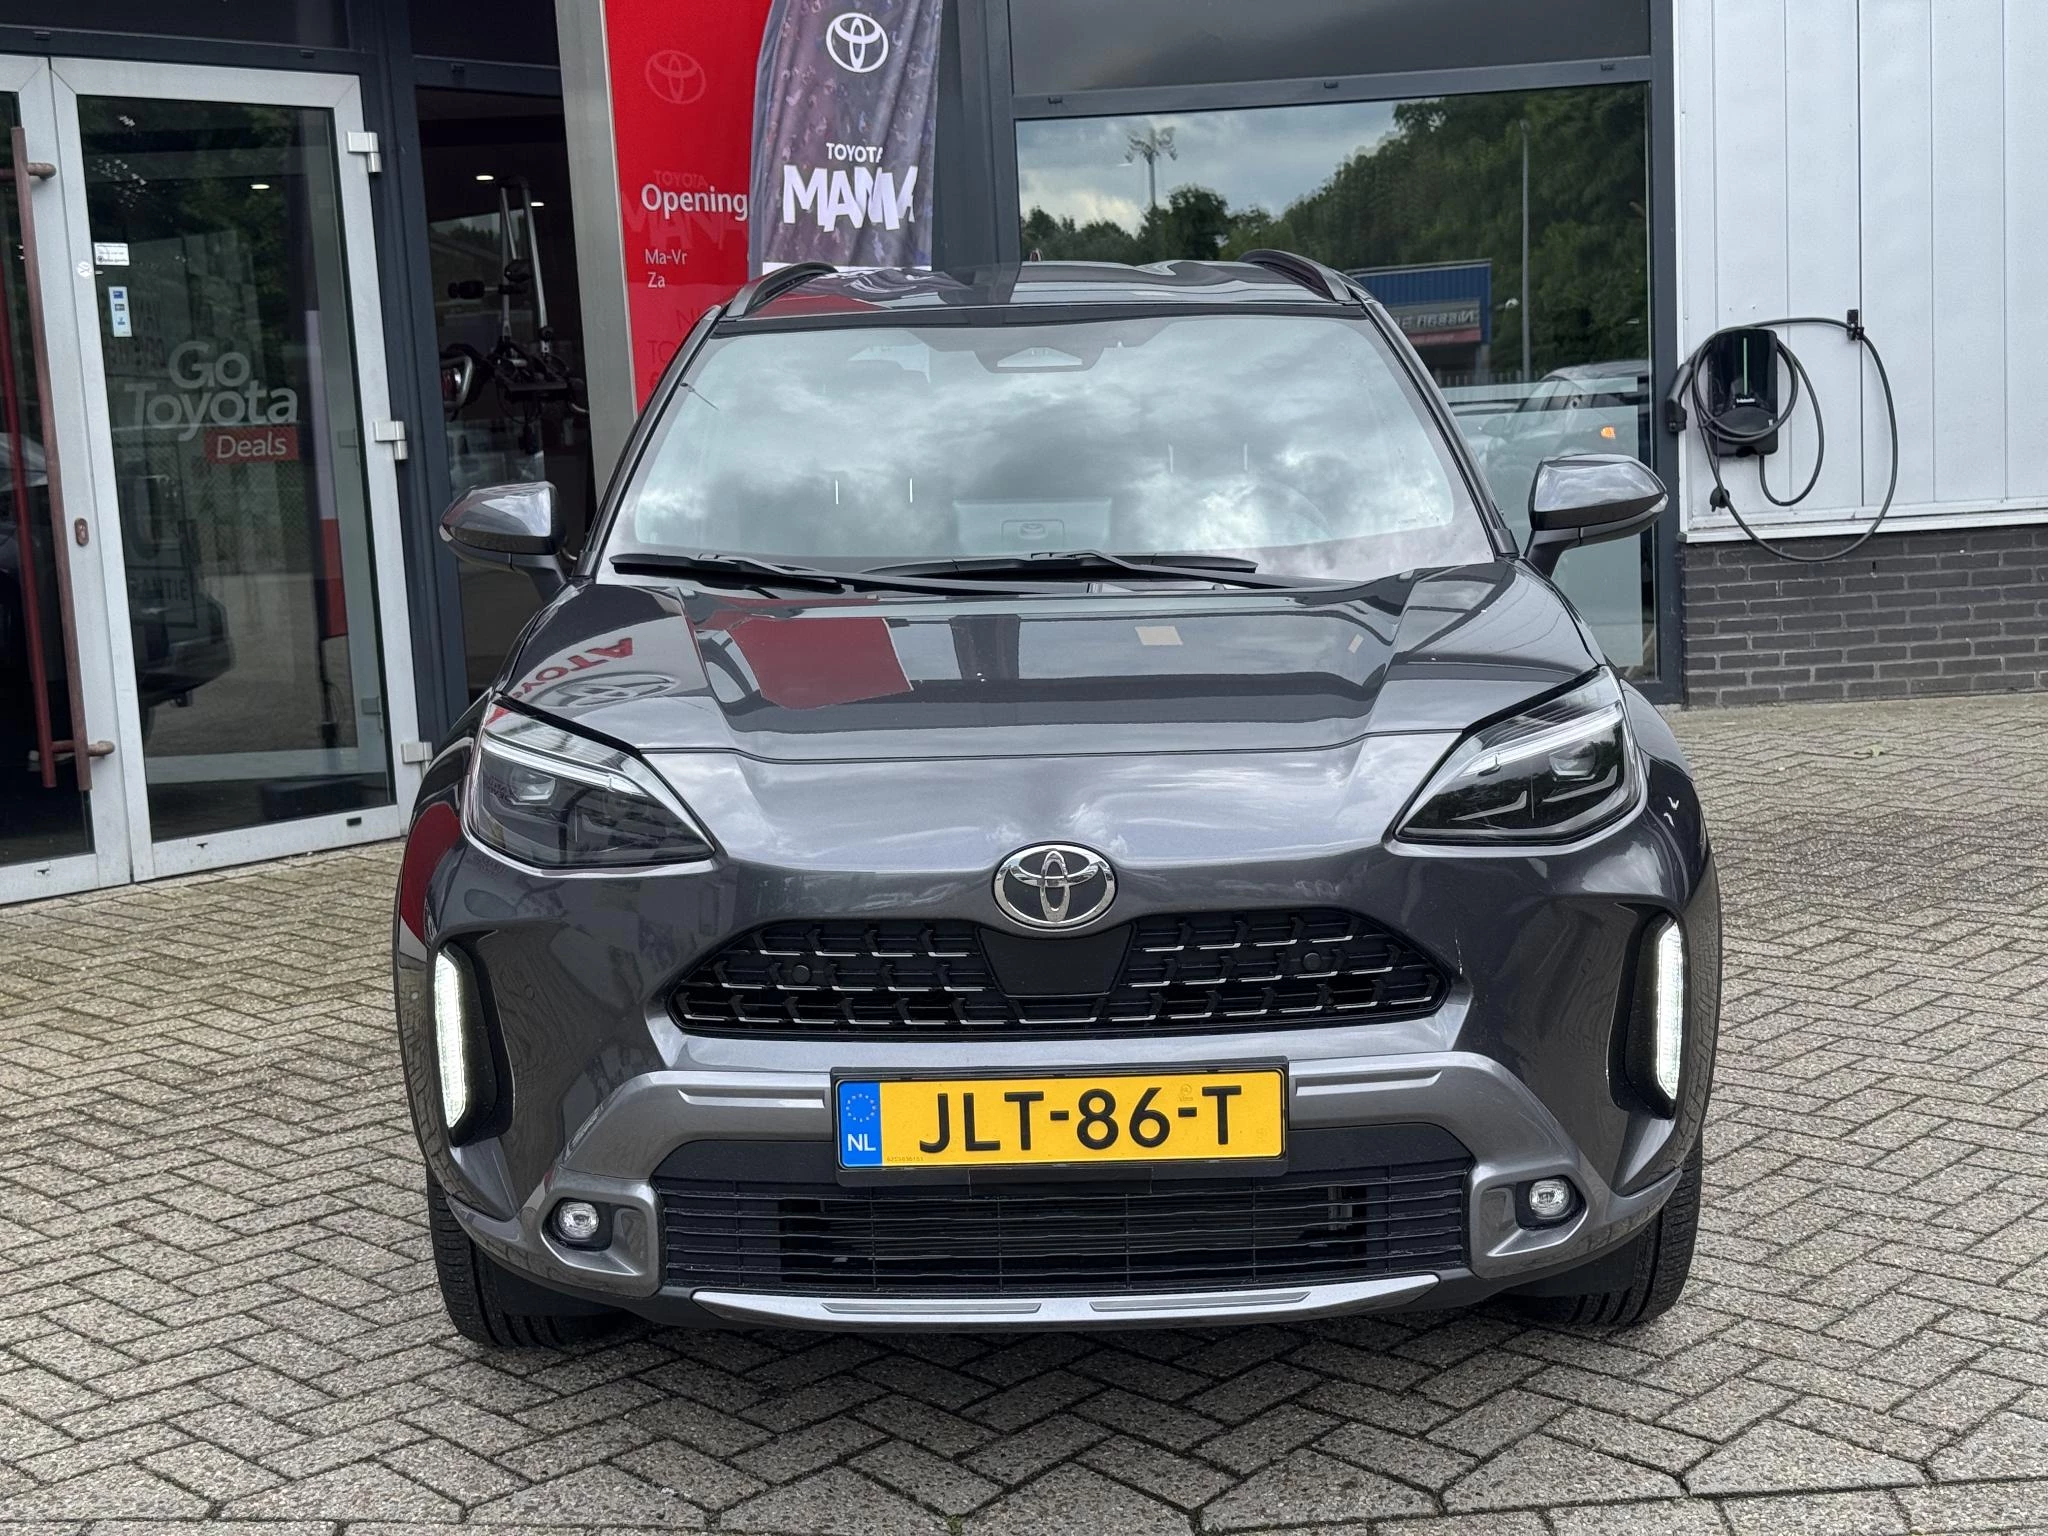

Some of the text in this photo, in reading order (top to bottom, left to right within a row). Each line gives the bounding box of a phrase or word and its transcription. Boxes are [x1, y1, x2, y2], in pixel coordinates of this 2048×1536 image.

[640, 183, 749, 222] Opening
[645, 249, 688, 266] Ma-Vr
[647, 272, 666, 289] Za
[168, 340, 250, 390] Go
[124, 379, 298, 442] Toyota
[216, 431, 287, 459] Deals
[918, 1085, 1243, 1154] JLT-86-T
[847, 1133, 876, 1152] NL
